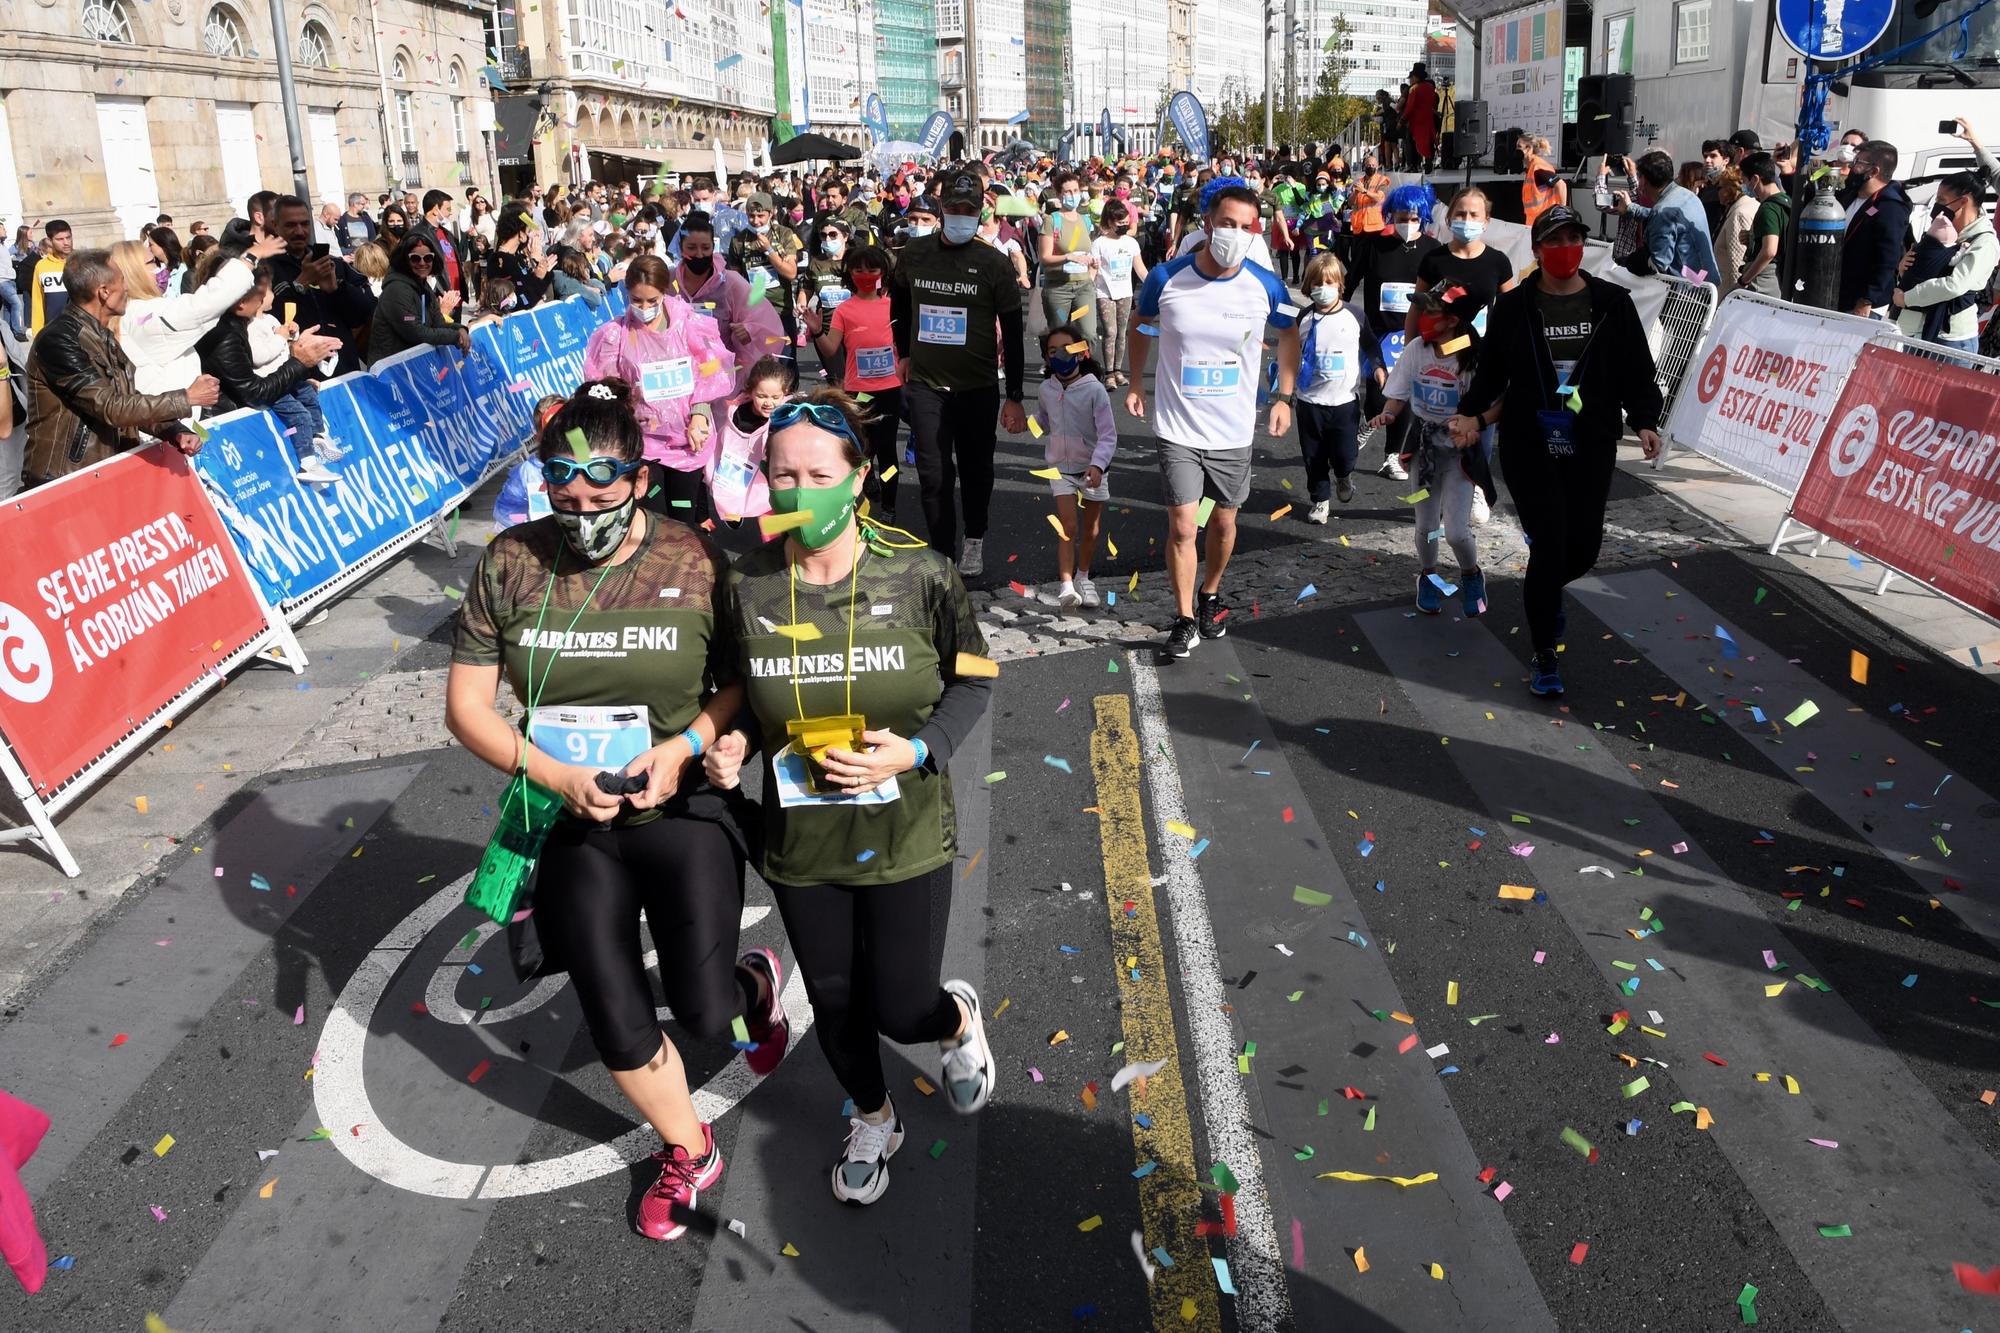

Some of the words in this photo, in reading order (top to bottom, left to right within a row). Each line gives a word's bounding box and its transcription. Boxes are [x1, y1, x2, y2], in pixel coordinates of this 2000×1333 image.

[914, 278, 952, 292] MARINES
[954, 282, 977, 296] ENKI
[927, 317, 956, 332] 143
[866, 355, 889, 369] 145
[1200, 369, 1224, 385] 19
[1733, 345, 1750, 375] O
[1744, 347, 1828, 398] DEPORTE
[654, 369, 684, 388] 115
[1421, 386, 1448, 405] 140
[1719, 386, 1769, 426] ESTÁ
[1757, 399, 1788, 435] DE
[1782, 406, 1827, 447] VOL
[1887, 410, 1915, 446] O
[1866, 459, 1937, 515] ESTÁ
[1923, 481, 1971, 528] DE
[37, 569, 75, 621] SE
[66, 548, 116, 604] CHE
[109, 511, 195, 582] PRESTA,
[64, 617, 94, 673] Á
[82, 578, 175, 659] CORUÑA
[163, 540, 229, 607] TAMÉN
[518, 628, 618, 650] MARINES
[622, 626, 678, 651] ENKI
[749, 653, 844, 678] MARINES
[850, 645, 905, 673] ENKI
[566, 732, 612, 763] 97
